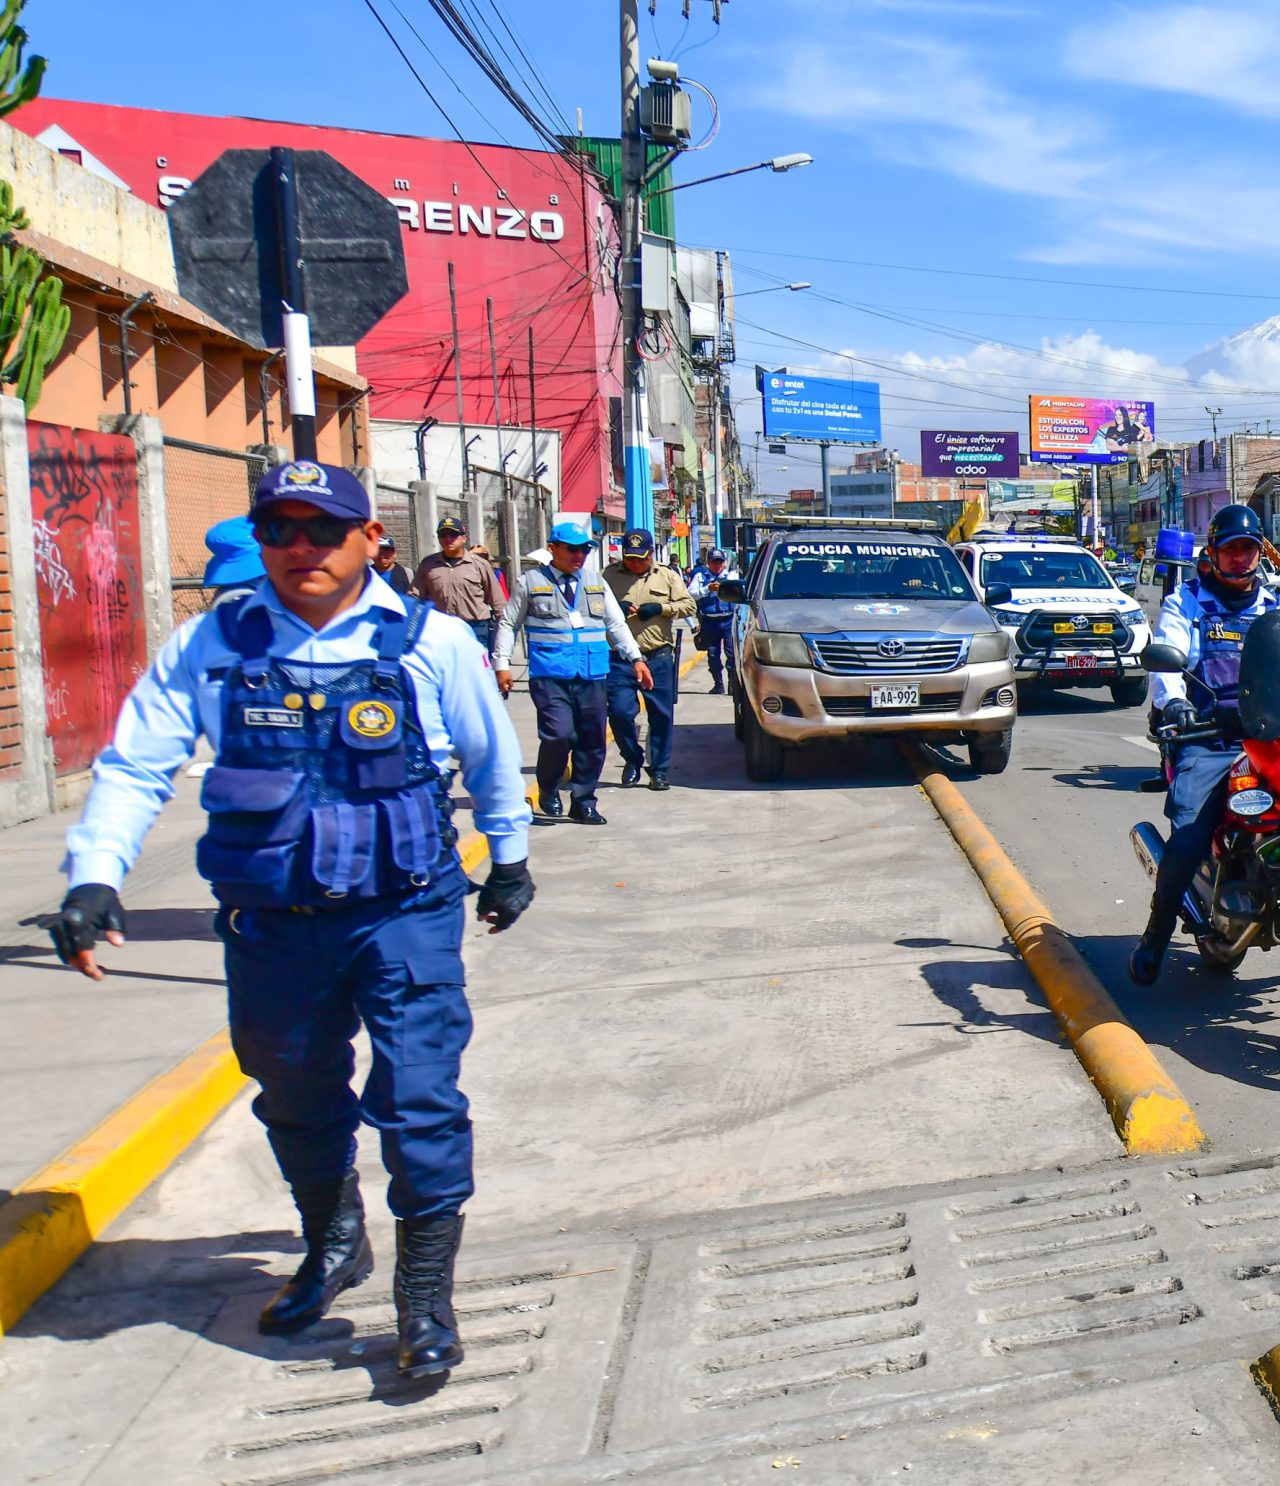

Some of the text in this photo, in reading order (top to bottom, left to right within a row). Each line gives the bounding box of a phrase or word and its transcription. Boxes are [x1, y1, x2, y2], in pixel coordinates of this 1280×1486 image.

[785, 381, 805, 389] entel
[772, 398, 799, 407] Disfrutar
[826, 402, 839, 410] todo
[1039, 418, 1067, 426] ESTUDIA
[1053, 426, 1088, 434] EXPERTOS
[934, 433, 1005, 445] El único software
[947, 444, 994, 454] empresarial
[939, 452, 1004, 463] que necesitarás
[955, 464, 986, 475] odoo
[787, 545, 940, 558] POLICIA MUNICIPAL
